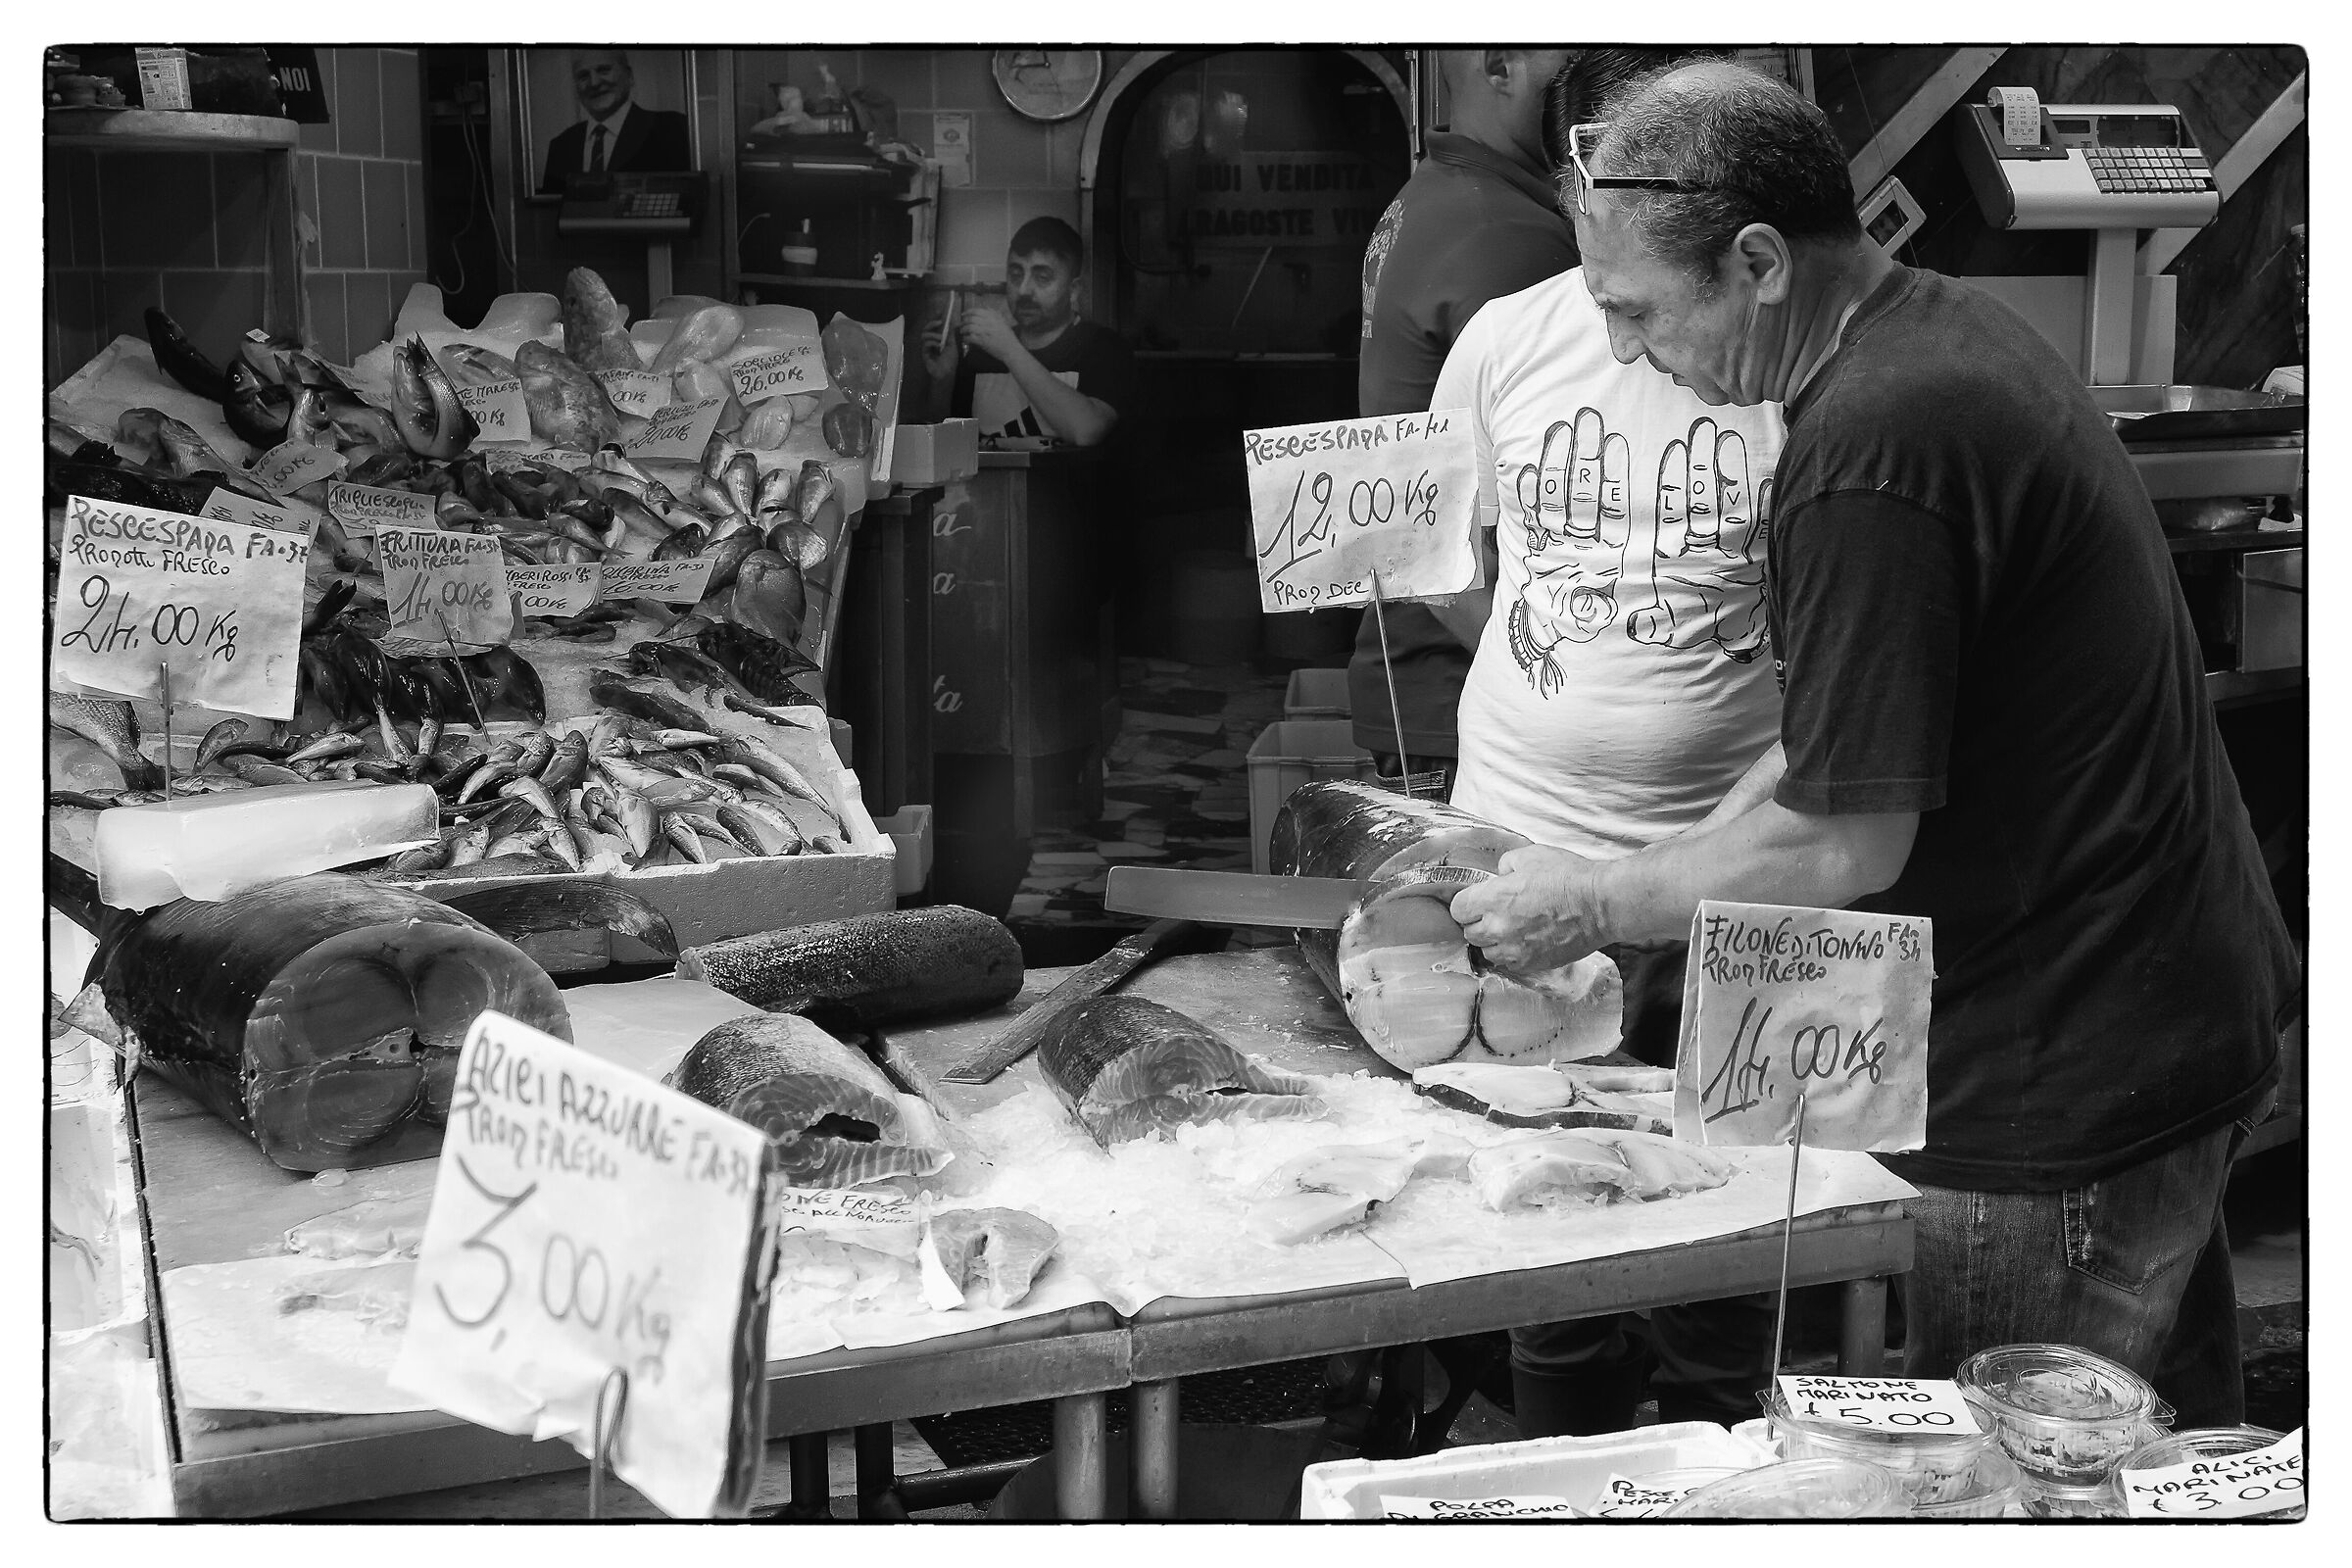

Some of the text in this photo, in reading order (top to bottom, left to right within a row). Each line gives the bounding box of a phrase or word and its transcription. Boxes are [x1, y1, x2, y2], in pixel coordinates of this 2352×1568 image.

[279, 67, 312, 92] NOI
[1257, 163, 1376, 192] VENDITA
[1403, 468, 1441, 527] Kg
[204, 609, 240, 663] Kg
[1843, 1016, 1889, 1085] Kg
[1795, 1377, 1918, 1391] SALMONE
[1795, 1389, 1933, 1403] MARINATO
[2132, 1454, 2302, 1495] MARINATE
[1429, 1498, 1515, 1511] POLPA
